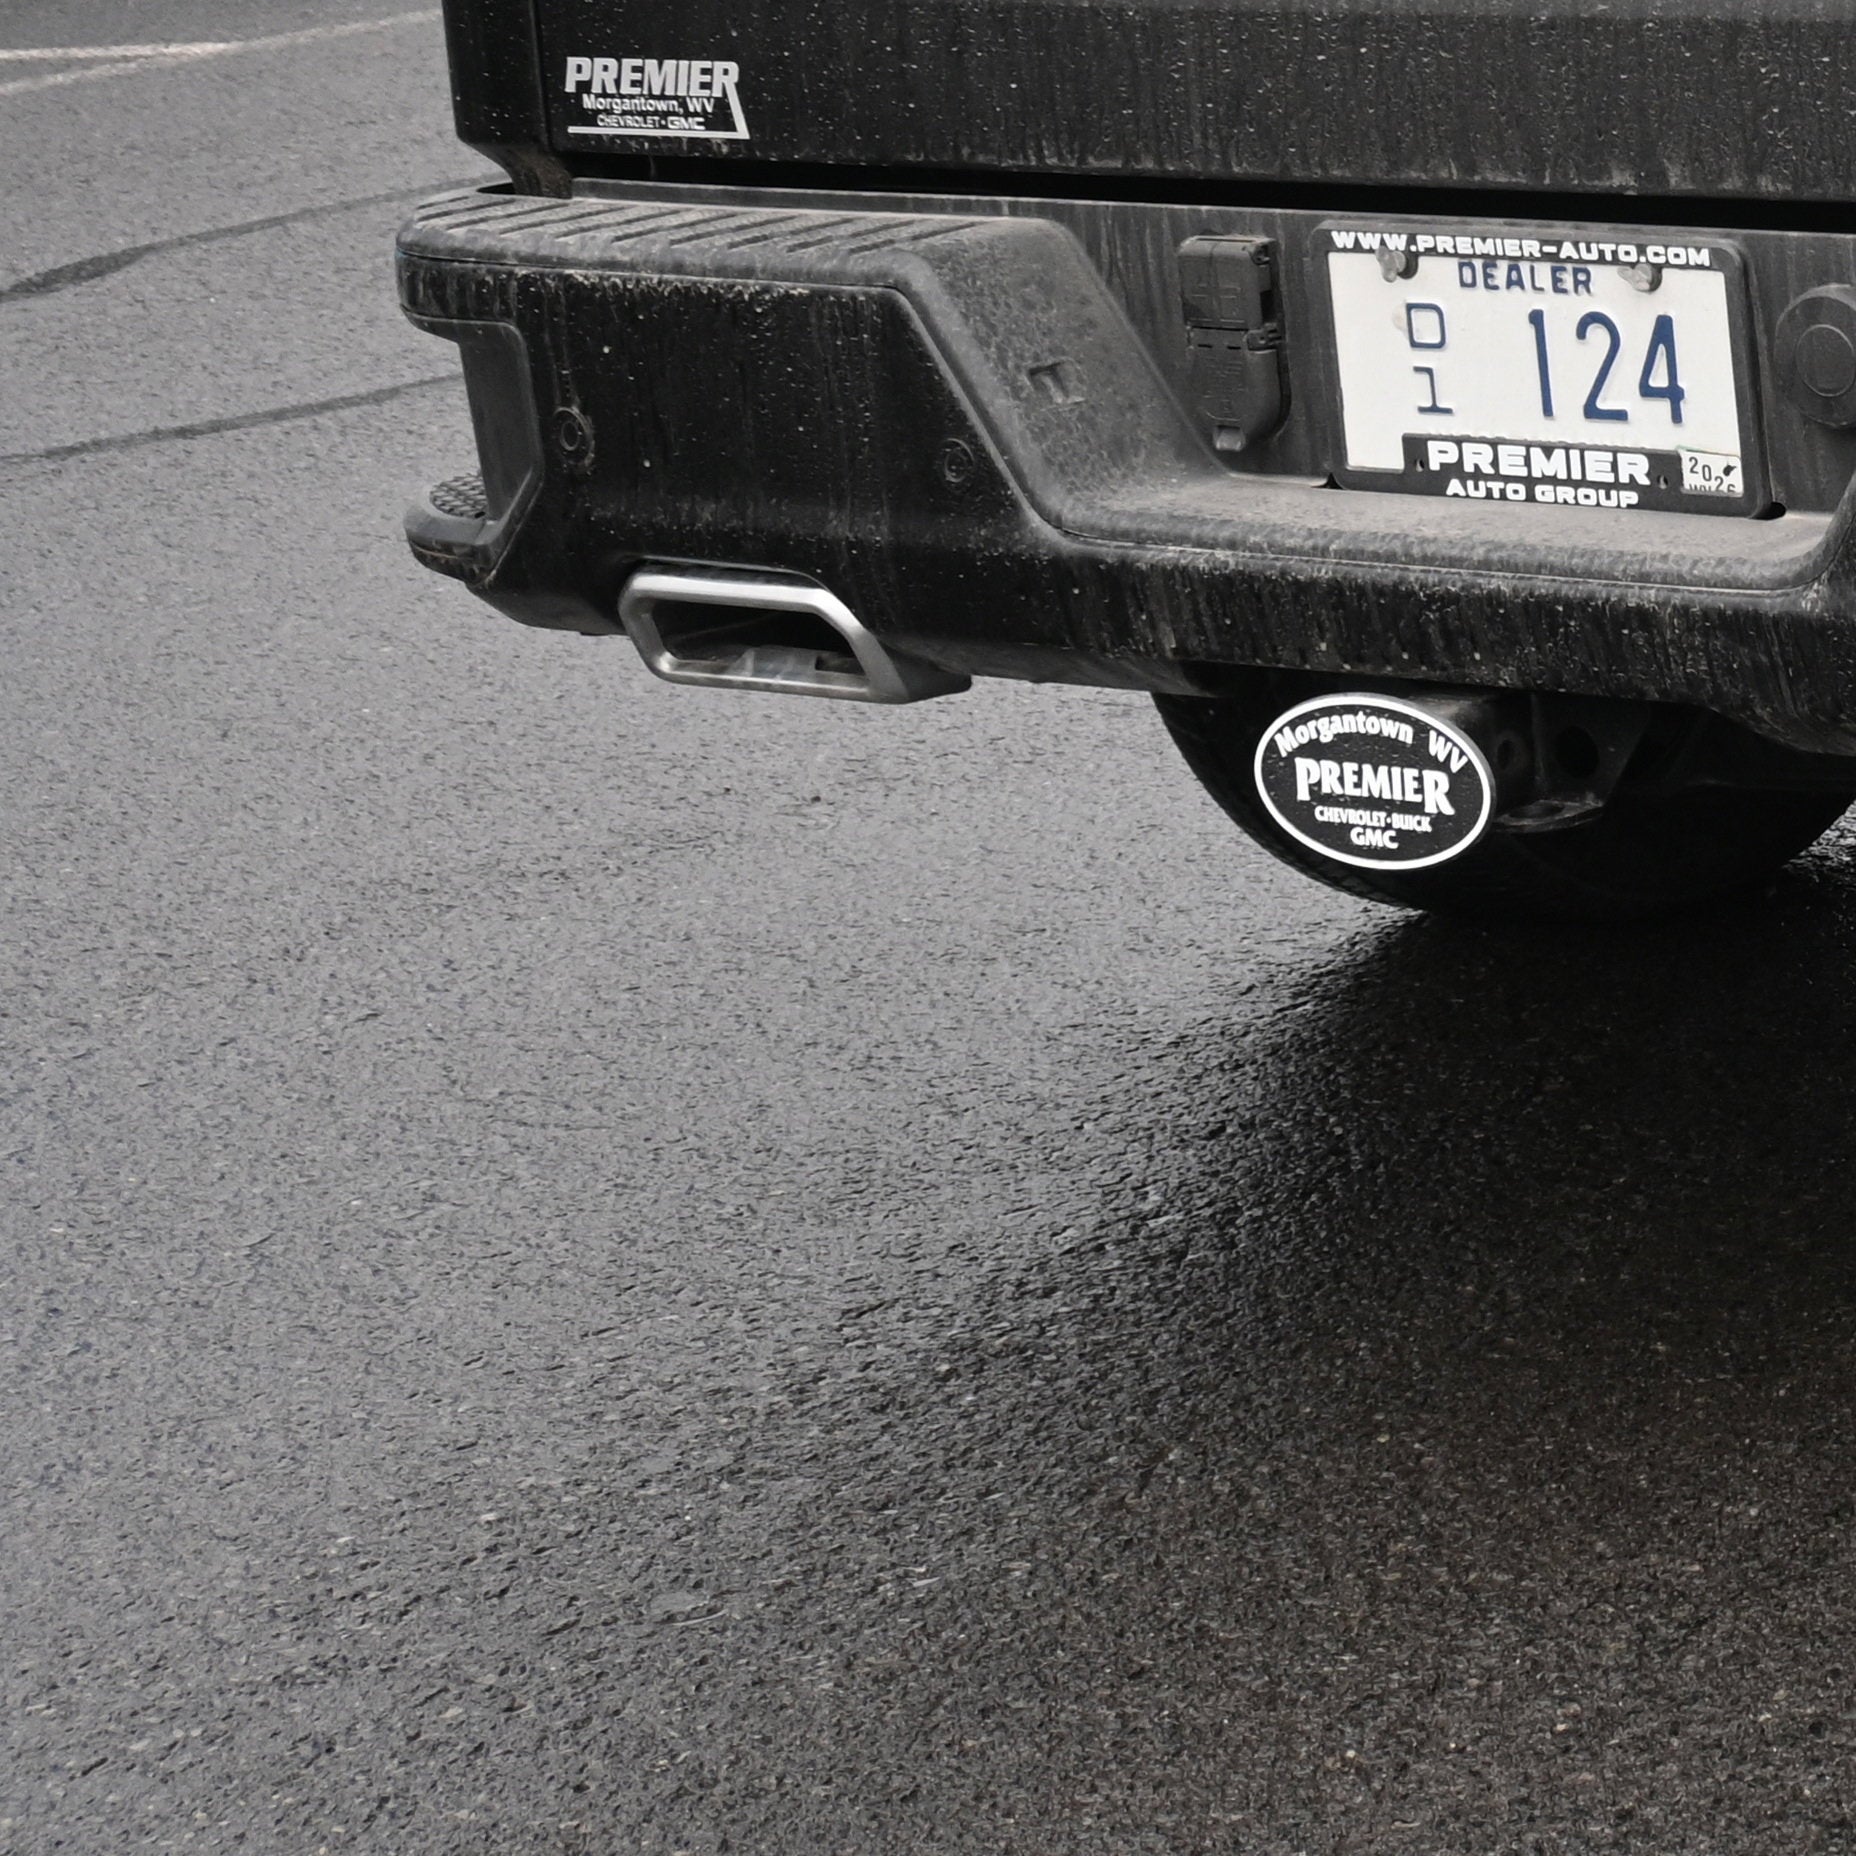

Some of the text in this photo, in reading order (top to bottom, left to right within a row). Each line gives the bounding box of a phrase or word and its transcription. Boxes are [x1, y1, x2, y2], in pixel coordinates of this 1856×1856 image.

[564, 56, 739, 97] PREMIER
[582, 94, 715, 114] Morgantown, WV
[1331, 230, 1711, 267] WWW.PREMIER-AUTO.COM
[1458, 260, 1592, 295] DEALER
[1405, 302, 1446, 349] D
[1528, 308, 1686, 424] 124
[1426, 440, 1651, 486] PREMIER
[1446, 478, 1639, 508] AUTO GROUP
[1274, 711, 1468, 773] Morgantown WV
[1294, 756, 1456, 816] PREMIER
[1350, 827, 1399, 850] GMC
